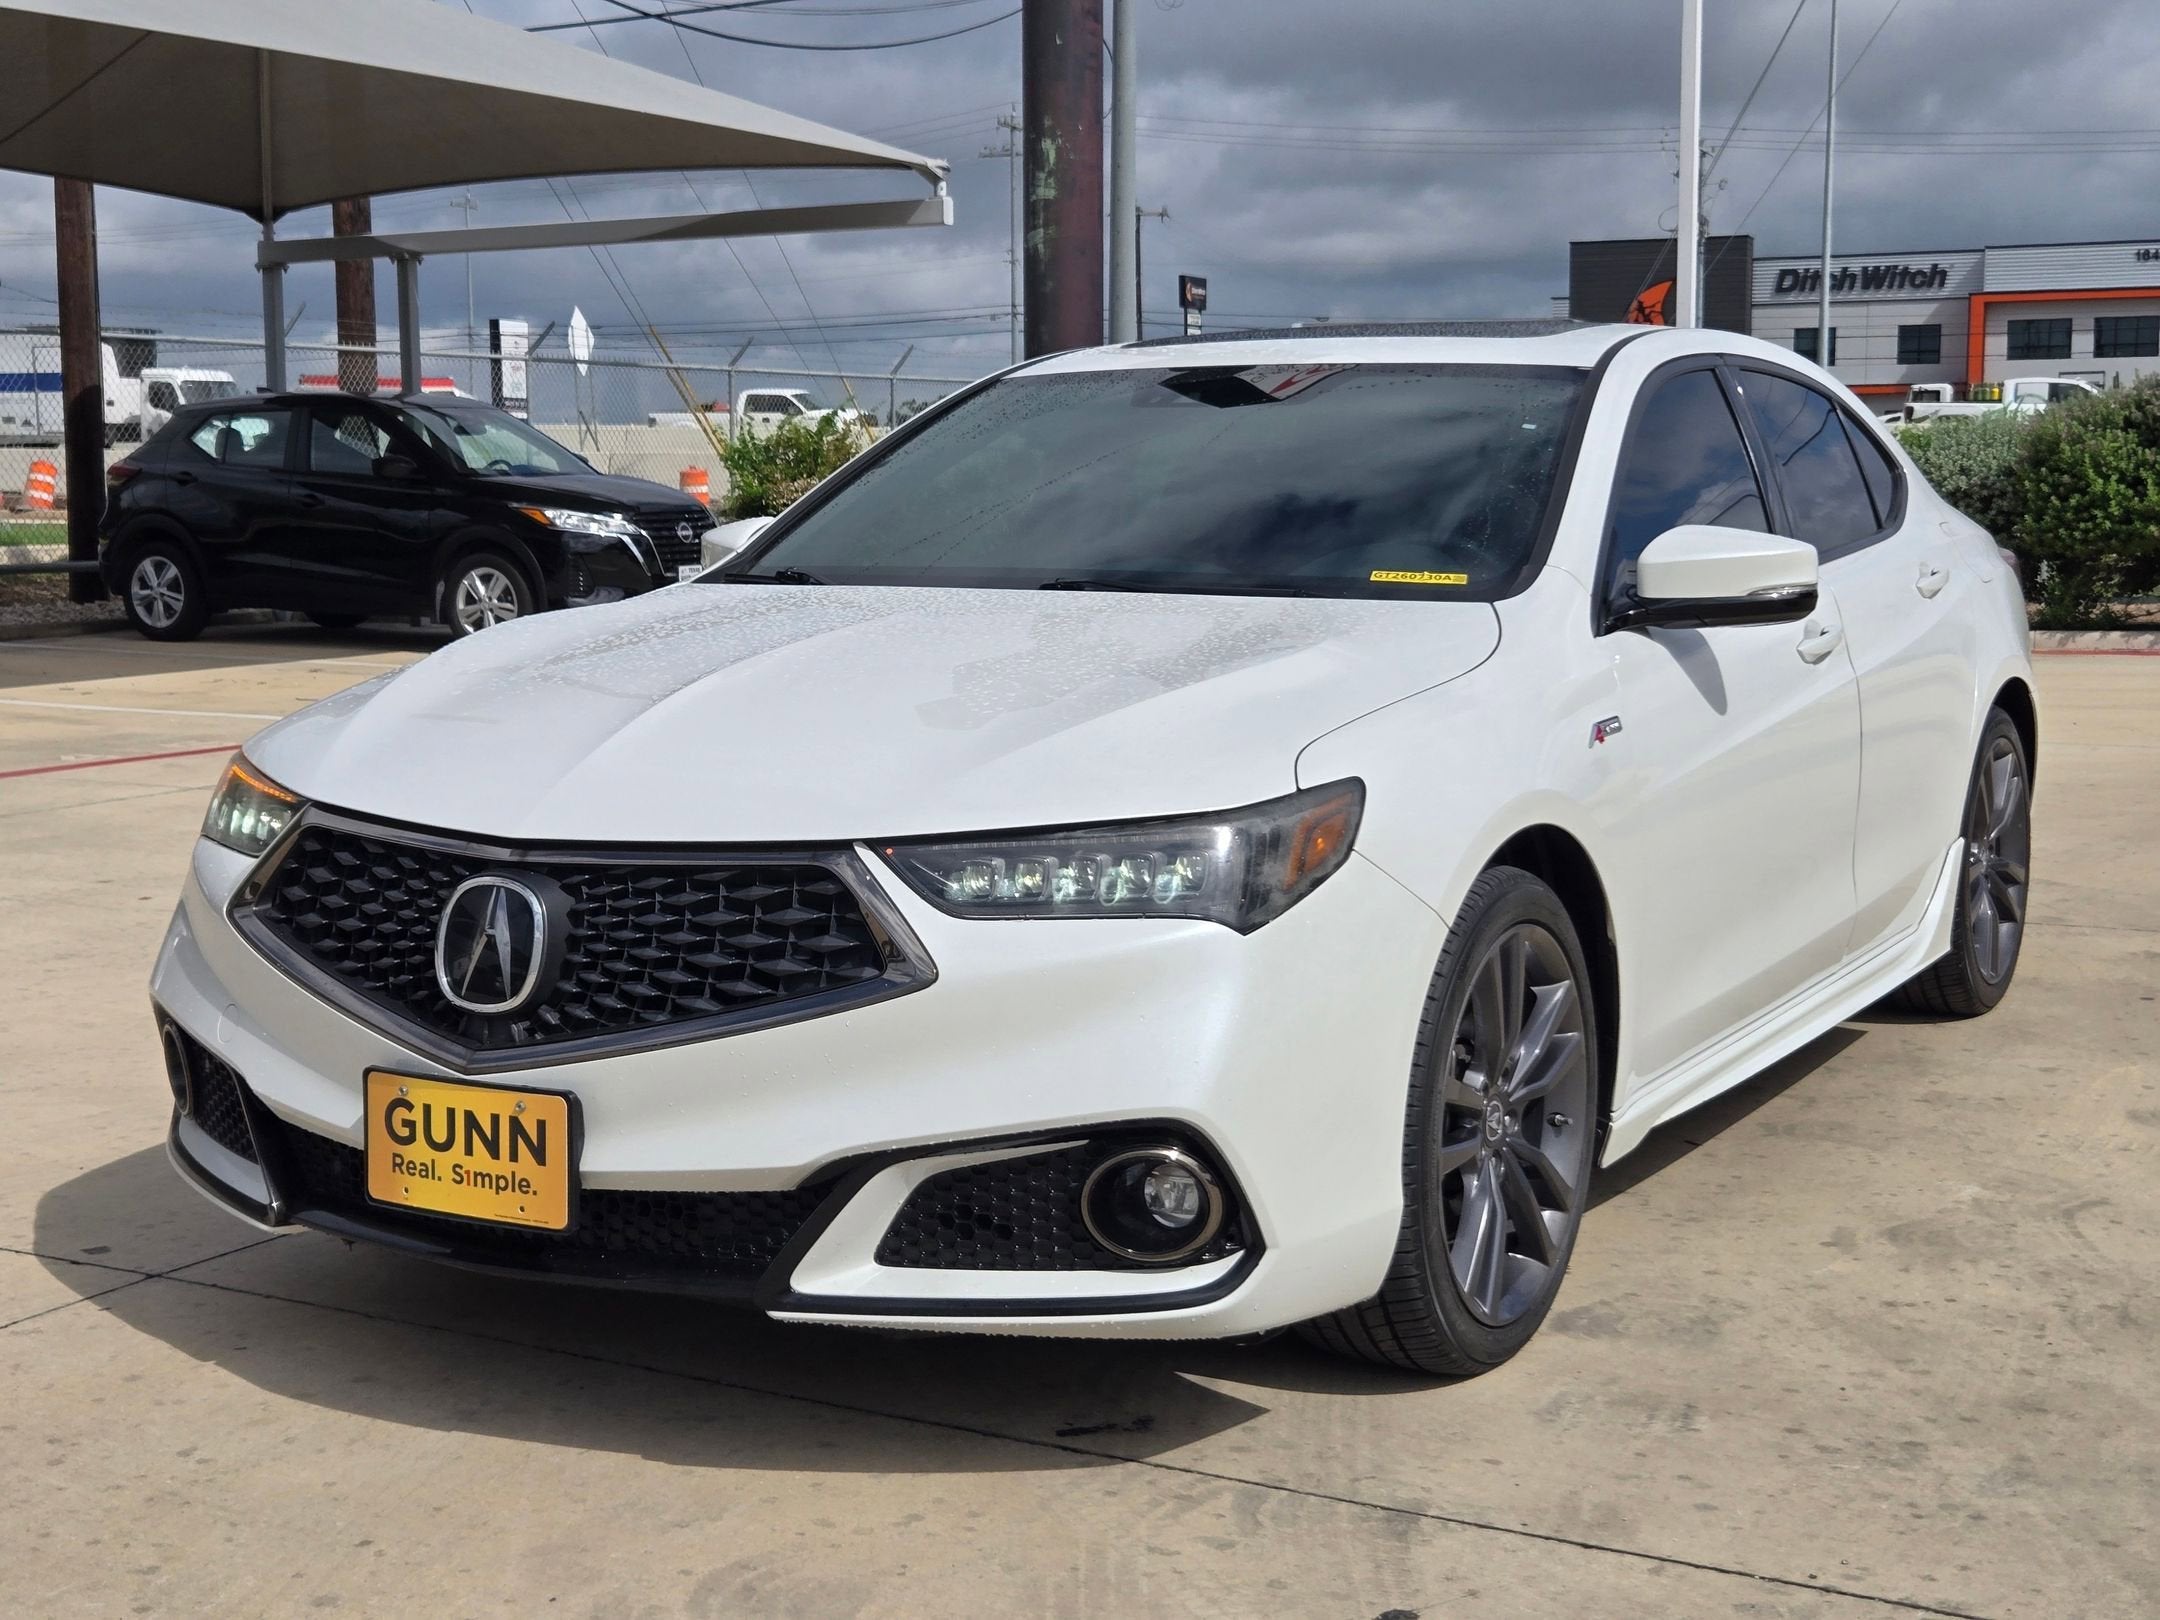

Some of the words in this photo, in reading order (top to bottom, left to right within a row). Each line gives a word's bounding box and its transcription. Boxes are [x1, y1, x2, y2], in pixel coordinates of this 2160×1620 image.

[1860, 263, 1948, 290] Witch
[384, 1097, 547, 1167] GUNN
[392, 1152, 442, 1182] Real.
